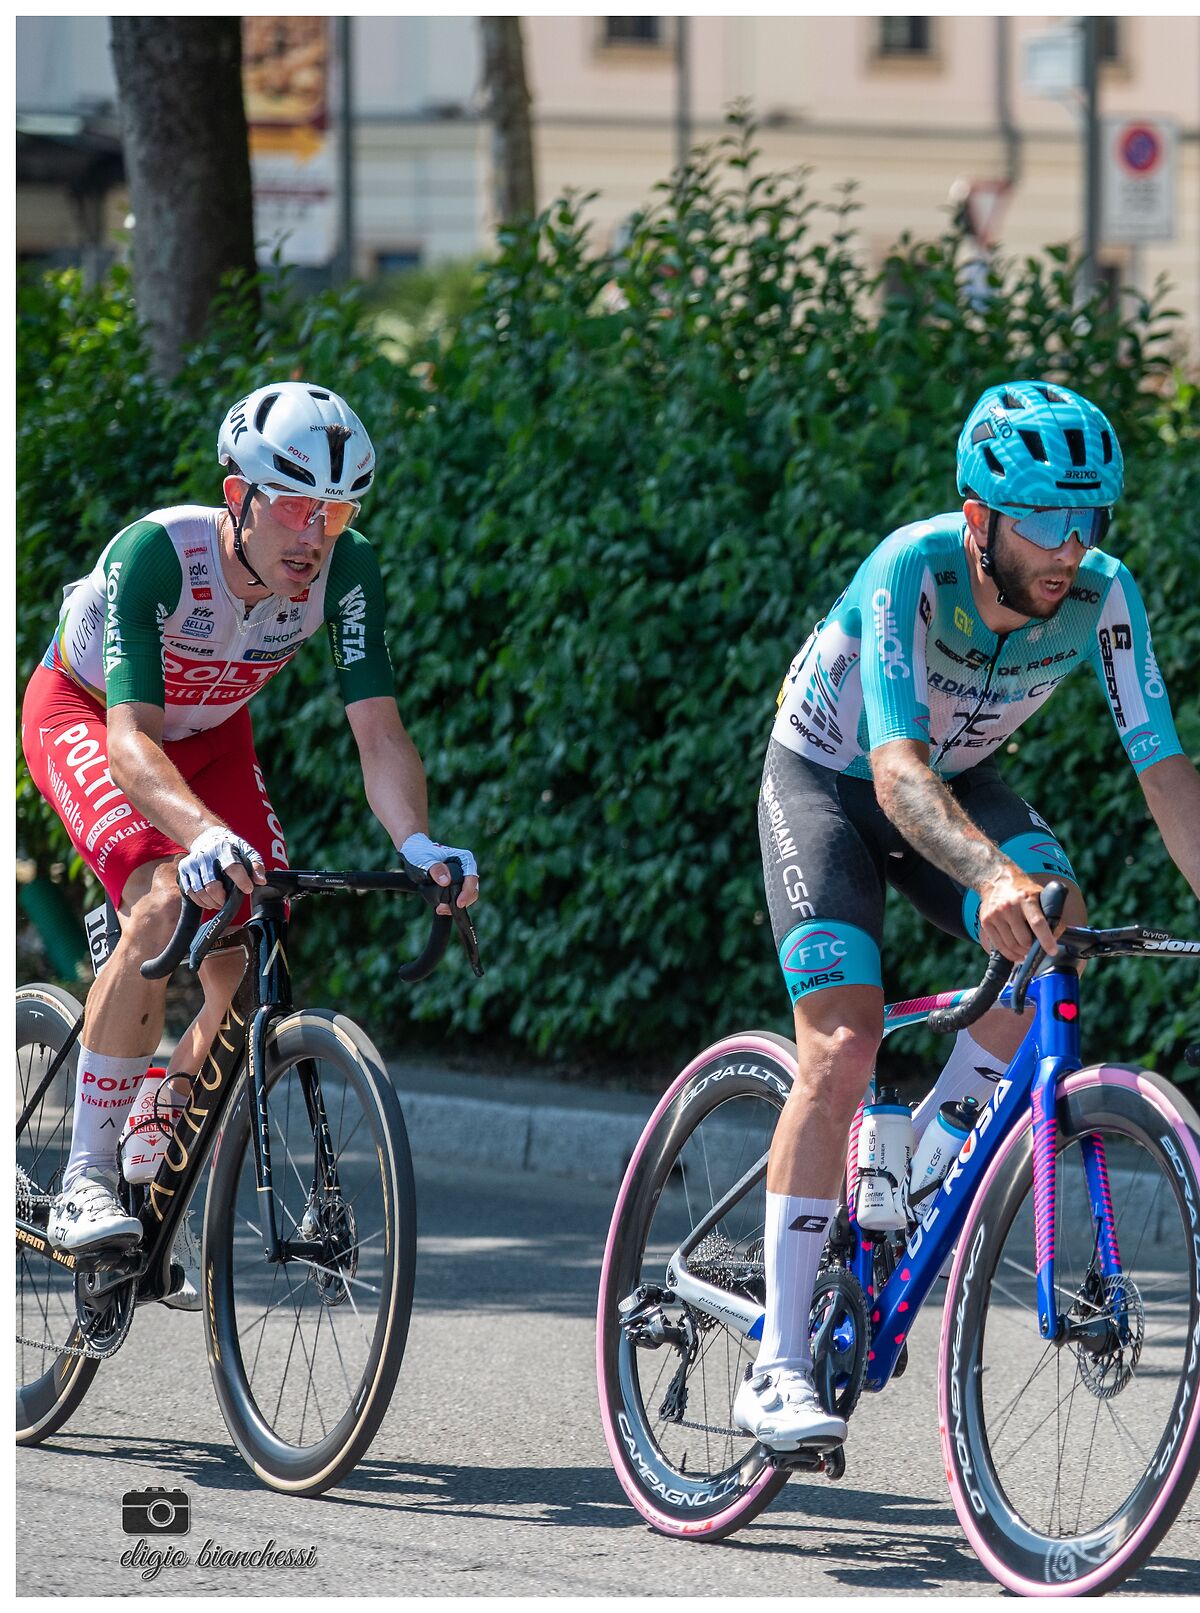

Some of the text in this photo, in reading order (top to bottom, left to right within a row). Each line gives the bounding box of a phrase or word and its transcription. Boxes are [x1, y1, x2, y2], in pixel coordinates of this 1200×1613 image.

[1064, 470, 1097, 480] BRIKO
[71, 600, 104, 665] AURUM
[106, 562, 122, 676] KOMETA
[185, 619, 211, 631] SELLA
[169, 640, 215, 654] LECHLER
[829, 654, 848, 687] GROUP
[998, 665, 1021, 676] DE
[1130, 735, 1160, 759] FTC
[54, 723, 123, 811] POLTI
[47, 754, 85, 840] VisitMalta
[88, 807, 126, 847] FINECO
[783, 864, 816, 918] CSF
[799, 940, 848, 966] FTC
[791, 971, 845, 997] EMBS
[82, 1071, 145, 1092] POLT
[907, 1079, 1013, 1260] DE ROSA
[930, 1147, 943, 1168] CSF
[1160, 1135, 1198, 1228] BORA
[618, 1413, 740, 1506] CAMPAGNOLO
